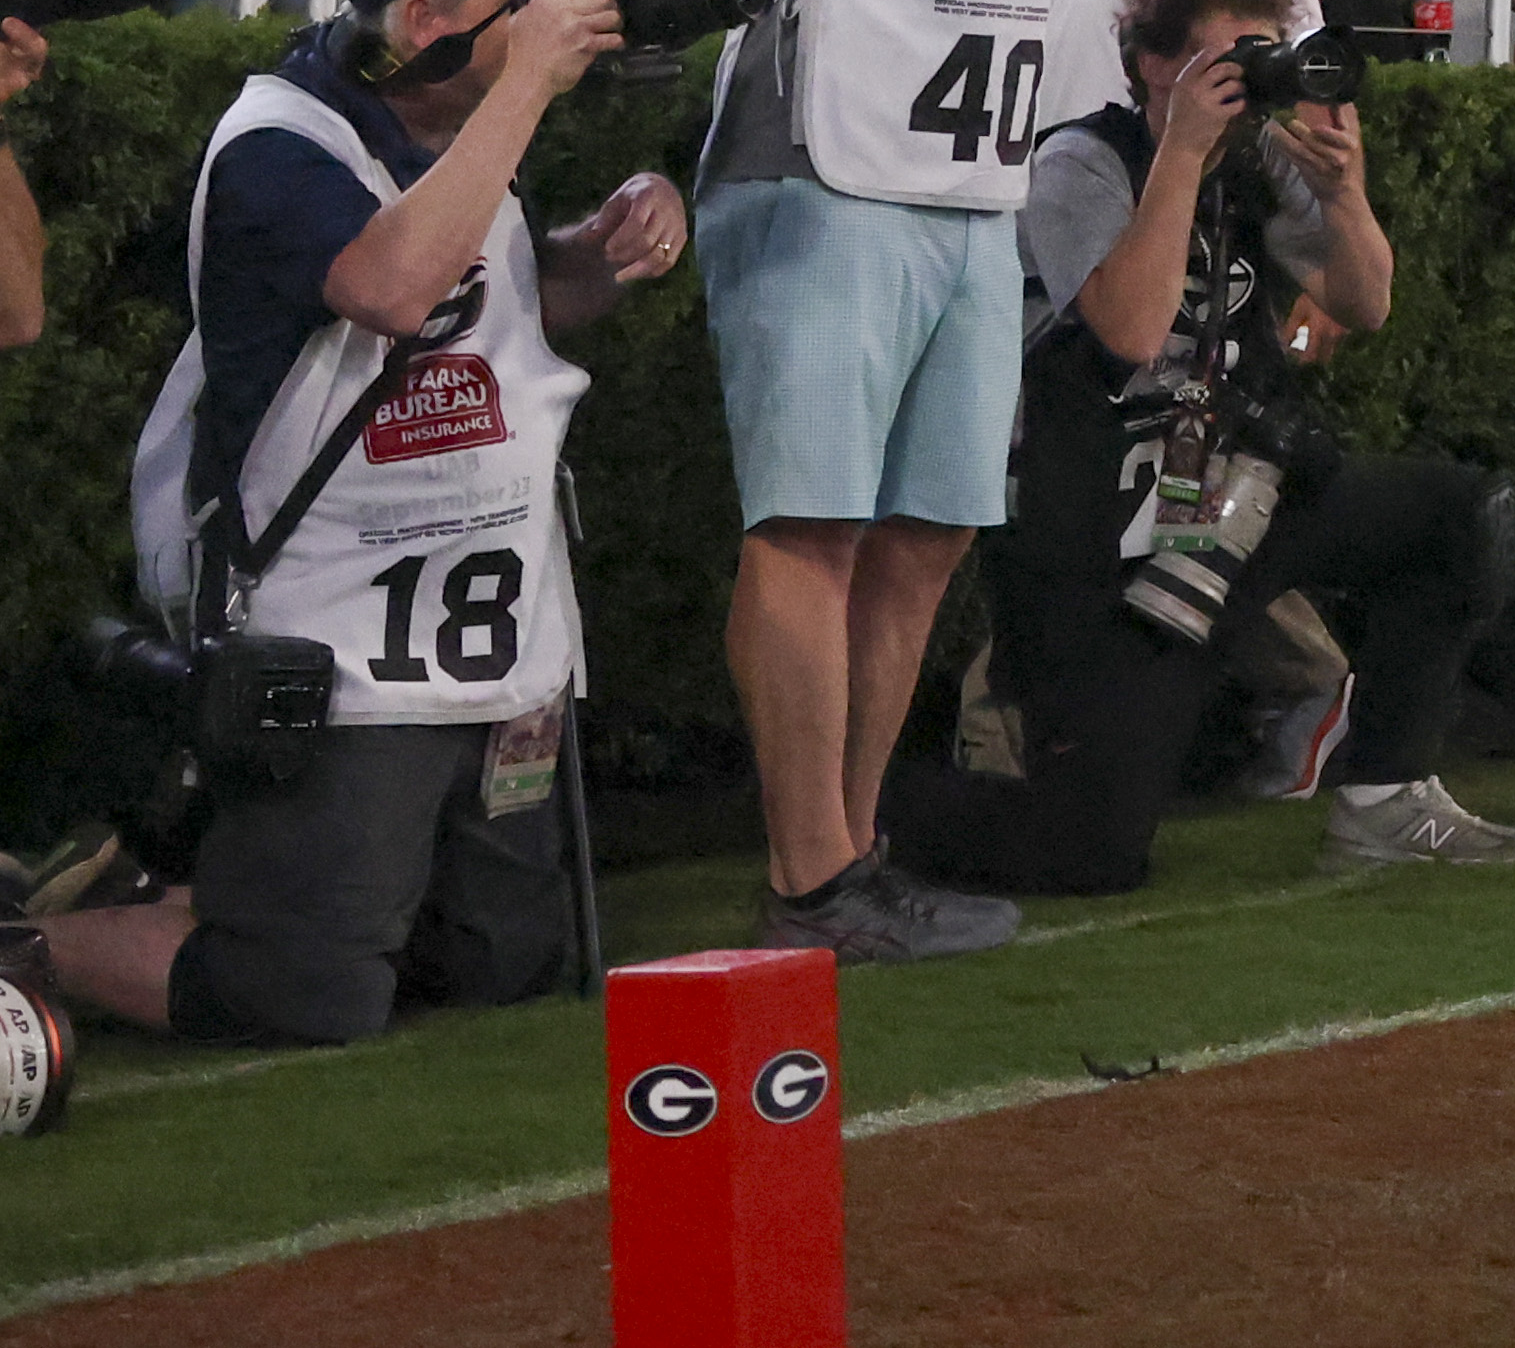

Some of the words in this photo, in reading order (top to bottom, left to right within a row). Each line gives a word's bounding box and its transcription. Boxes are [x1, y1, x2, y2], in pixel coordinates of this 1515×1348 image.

[908, 32, 1044, 166] 40
[407, 367, 480, 391] FARM
[375, 382, 487, 426] BUREAU
[400, 414, 493, 444] INSURANCE
[366, 547, 524, 683] 18
